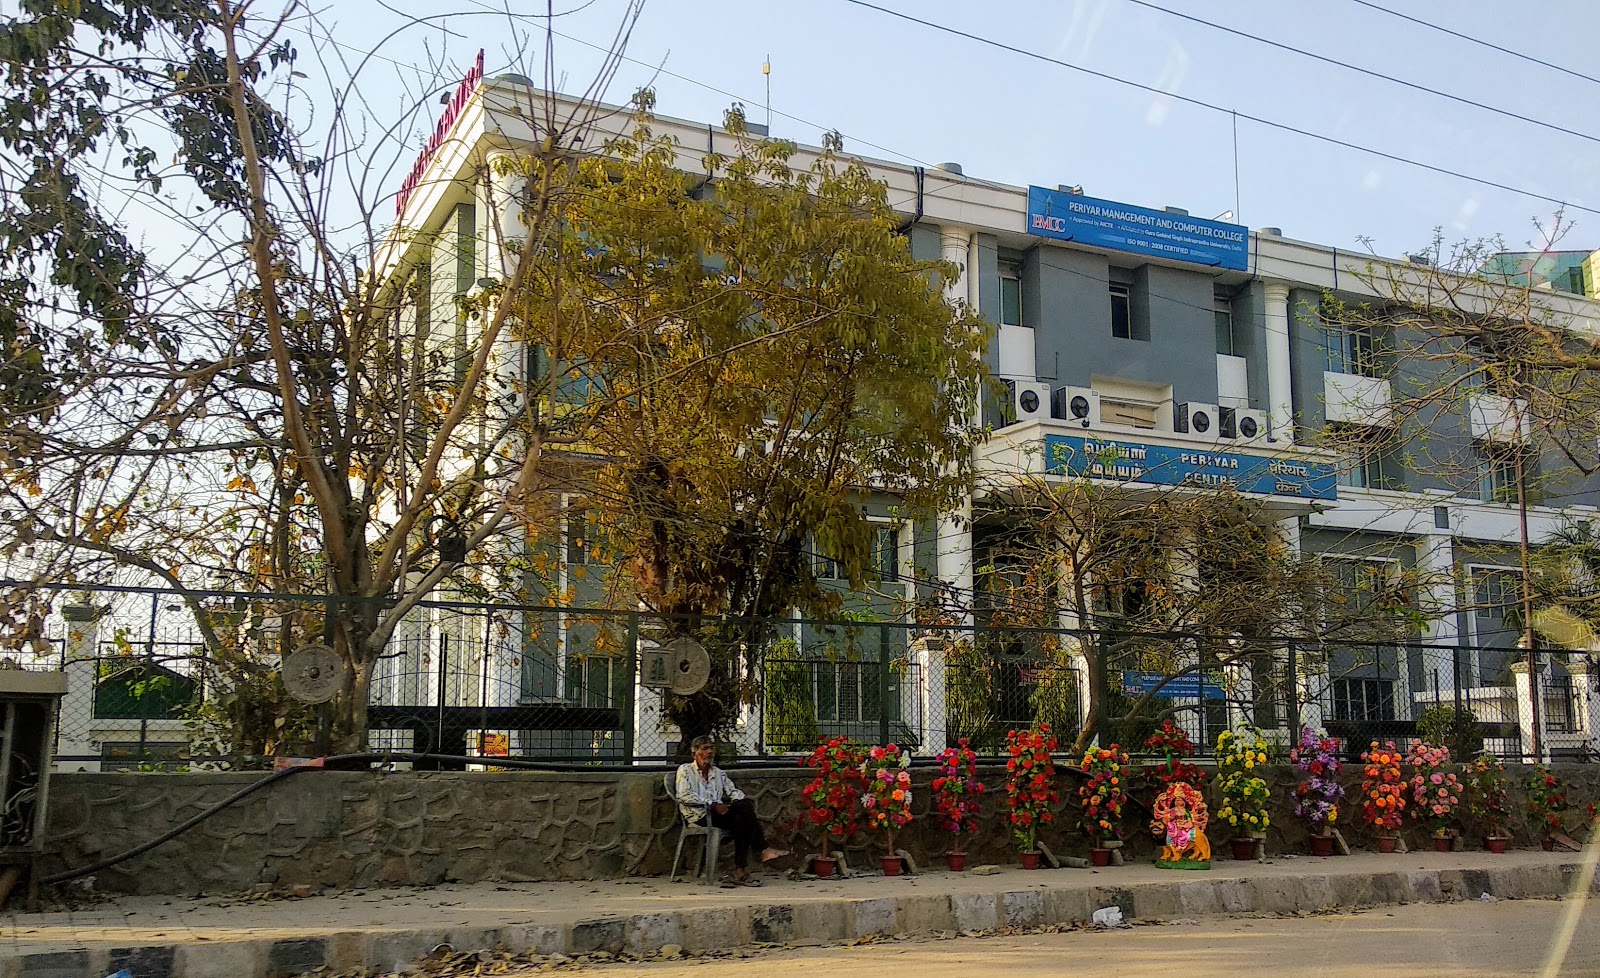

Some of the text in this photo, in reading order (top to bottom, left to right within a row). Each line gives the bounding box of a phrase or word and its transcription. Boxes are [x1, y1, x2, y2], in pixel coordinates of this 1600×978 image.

[1069, 201, 1243, 242] PERIYAR MANAGEMENT AND COMPUTER COLLEGE
[1072, 216, 1093, 225] Approved
[1163, 244, 1189, 254] CERTIFIED
[1180, 452, 1239, 469] PERIYAR
